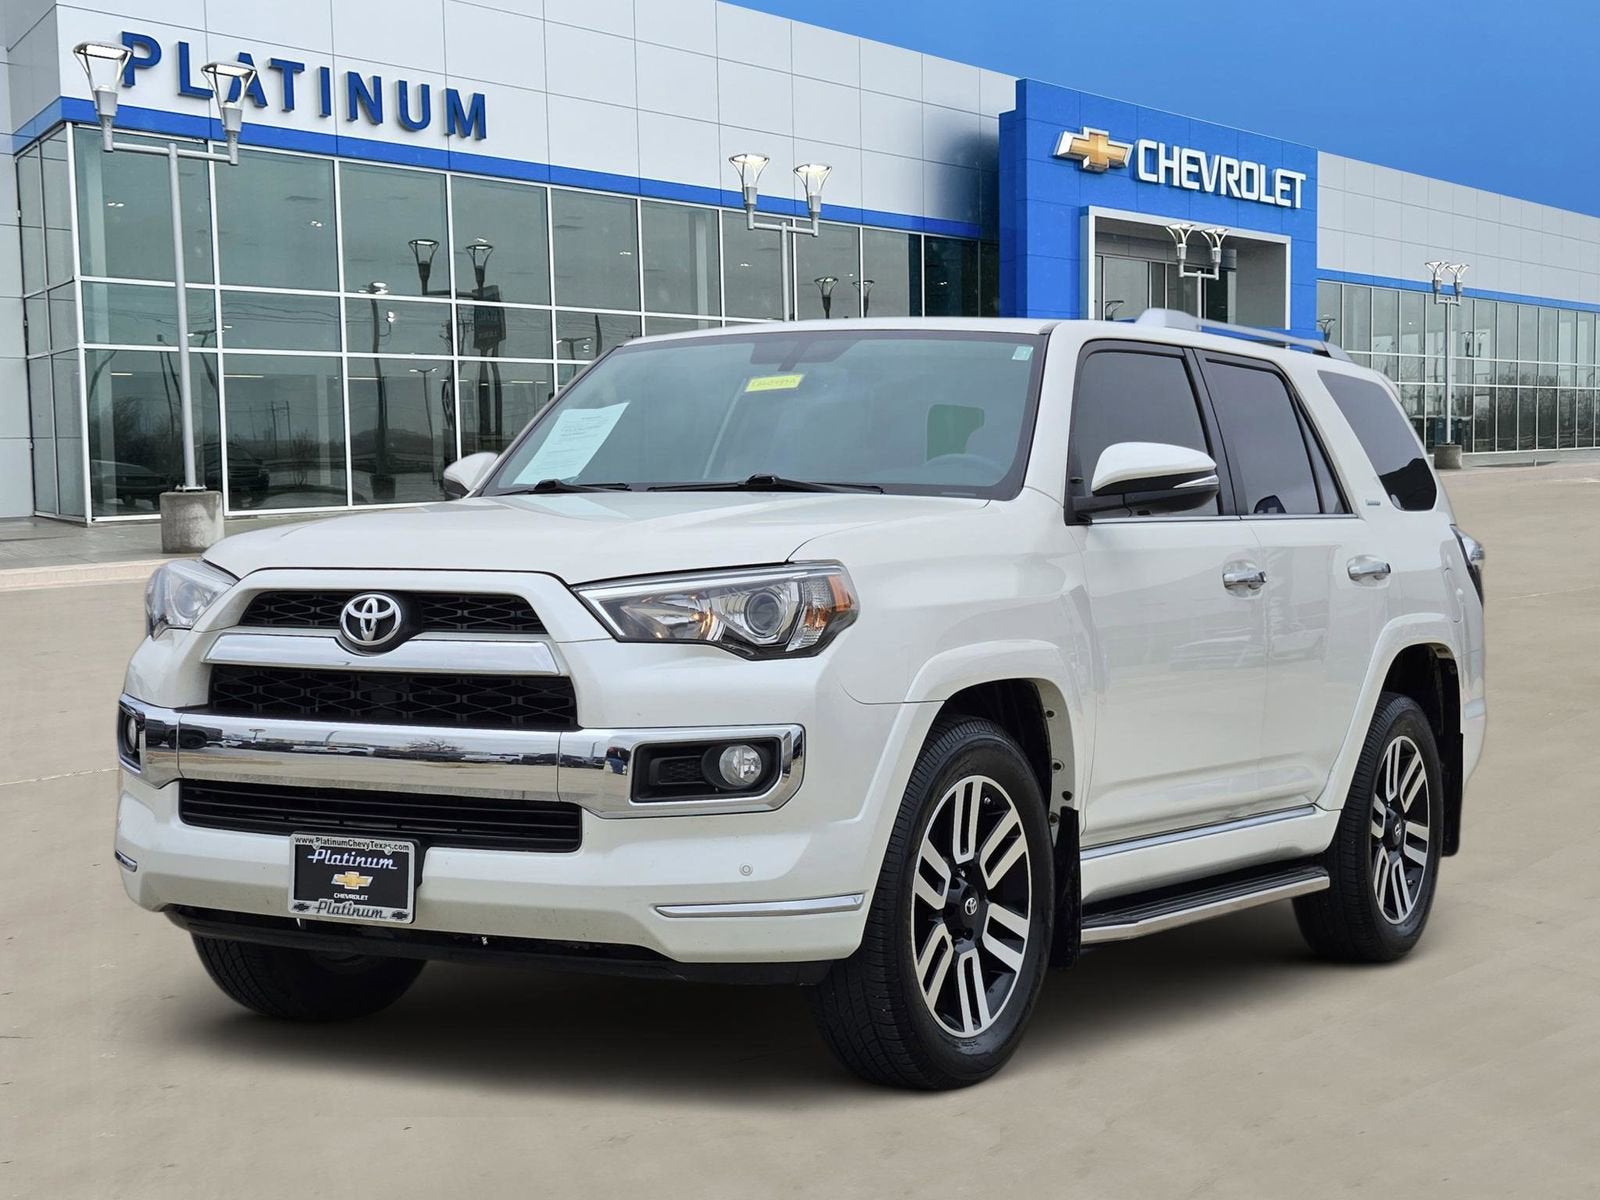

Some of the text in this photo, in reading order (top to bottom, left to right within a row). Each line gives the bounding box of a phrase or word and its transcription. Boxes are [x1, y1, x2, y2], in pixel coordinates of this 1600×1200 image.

[121, 31, 487, 141] PLATINUM
[1137, 139, 1306, 208] CHEVROLET
[307, 849, 398, 869] Platinum
[333, 892, 368, 901] CHEVROLET
[313, 901, 388, 919] Platinum
